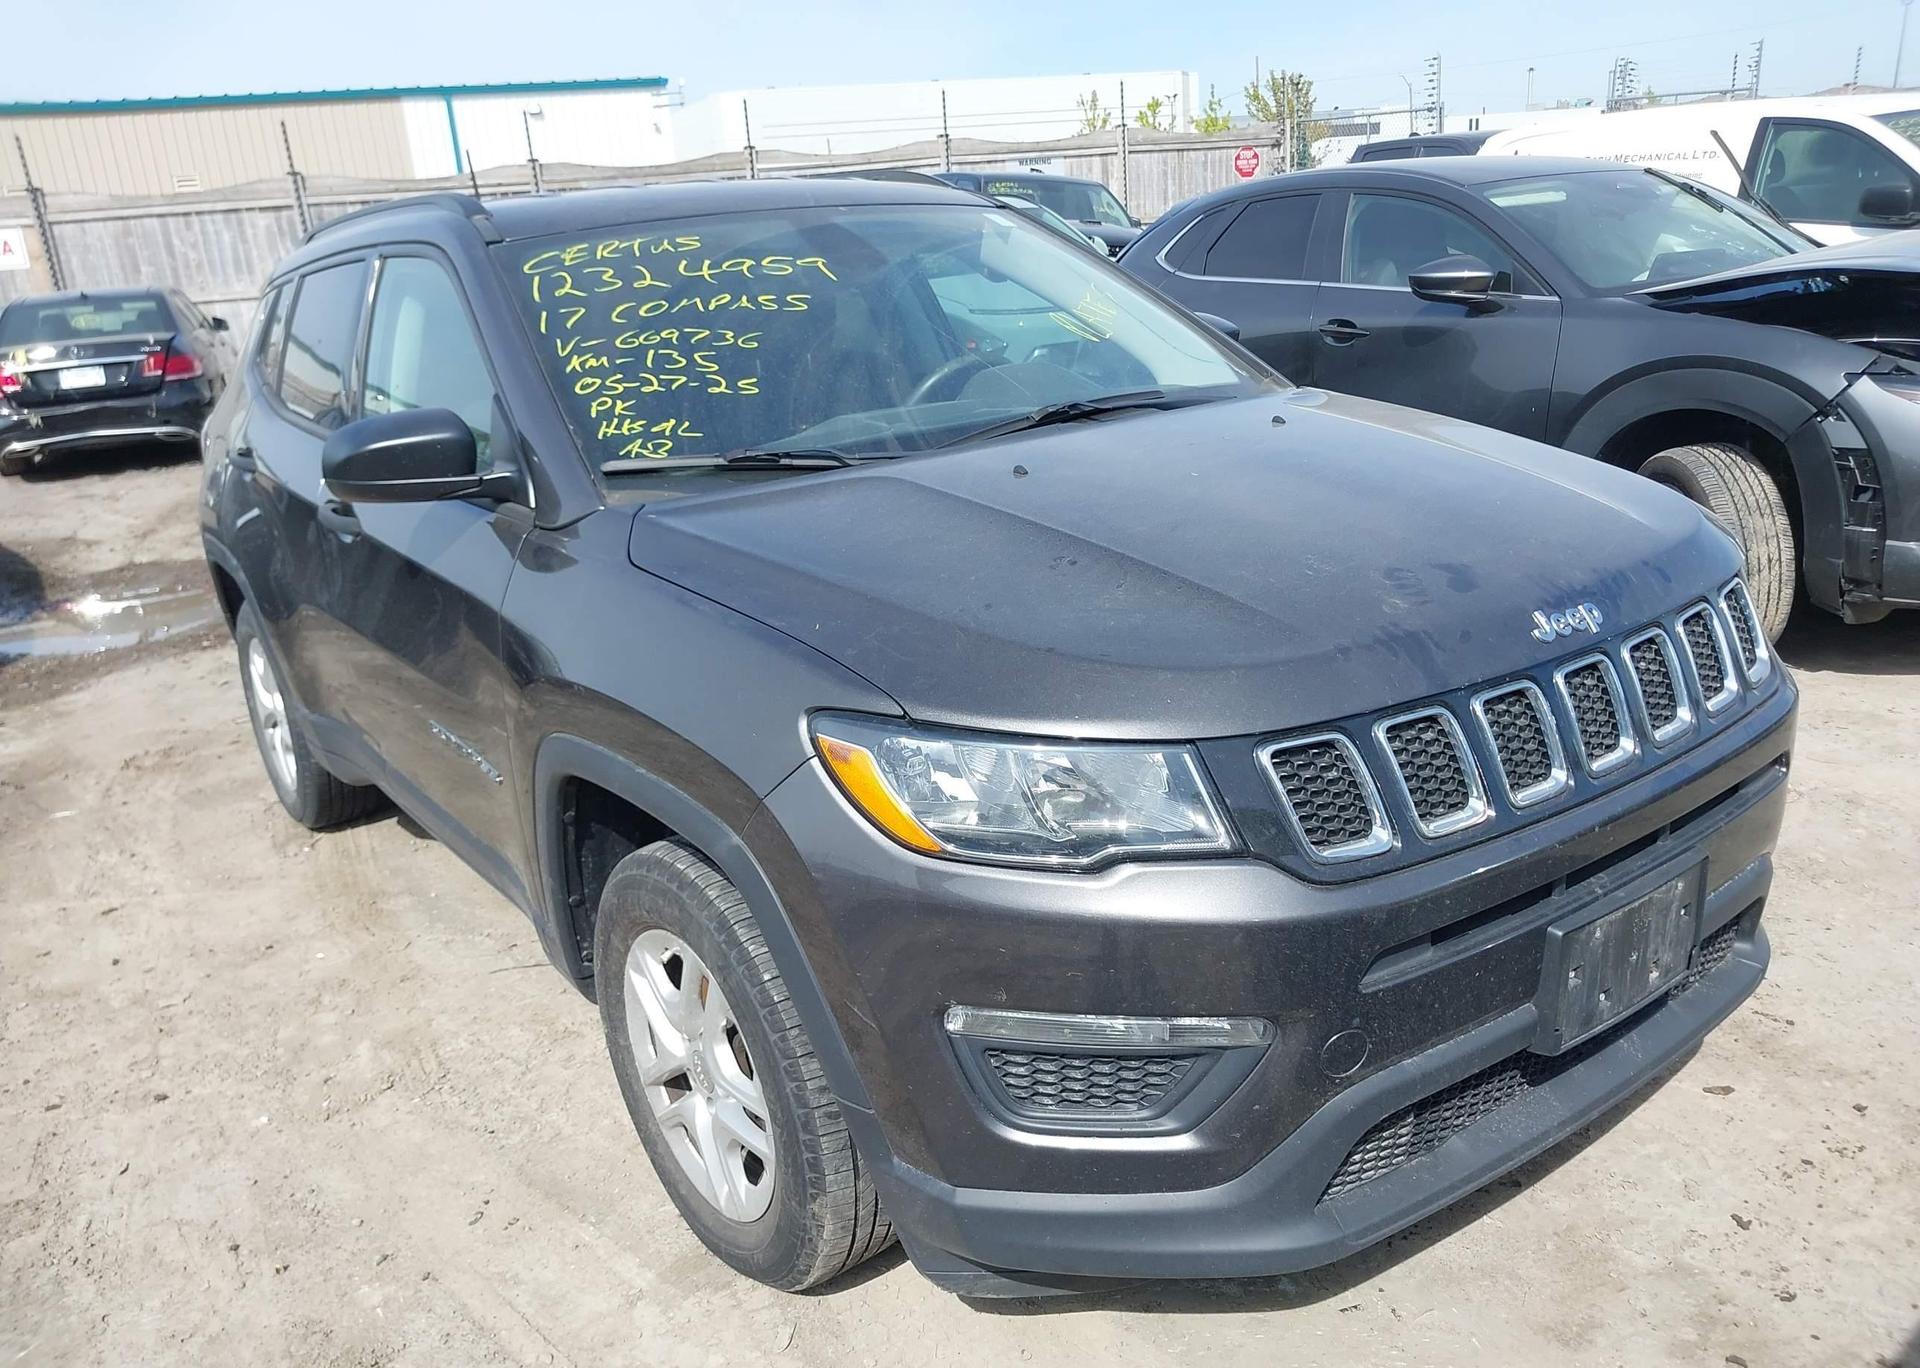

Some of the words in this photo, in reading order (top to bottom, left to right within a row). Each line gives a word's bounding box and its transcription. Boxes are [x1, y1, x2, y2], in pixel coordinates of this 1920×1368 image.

[1018, 157, 1052, 166] WARNING
[1239, 150, 1255, 160] STOP
[1613, 152, 1689, 163] MECHANICAL
[1691, 149, 1721, 160] LTD.
[522, 236, 702, 274] CERTUS
[540, 306, 586, 334] 17
[611, 293, 812, 323] COMPASS
[574, 373, 760, 395] 05-27-25
[590, 396, 638, 418] PK
[1530, 602, 1603, 644] Jeep
